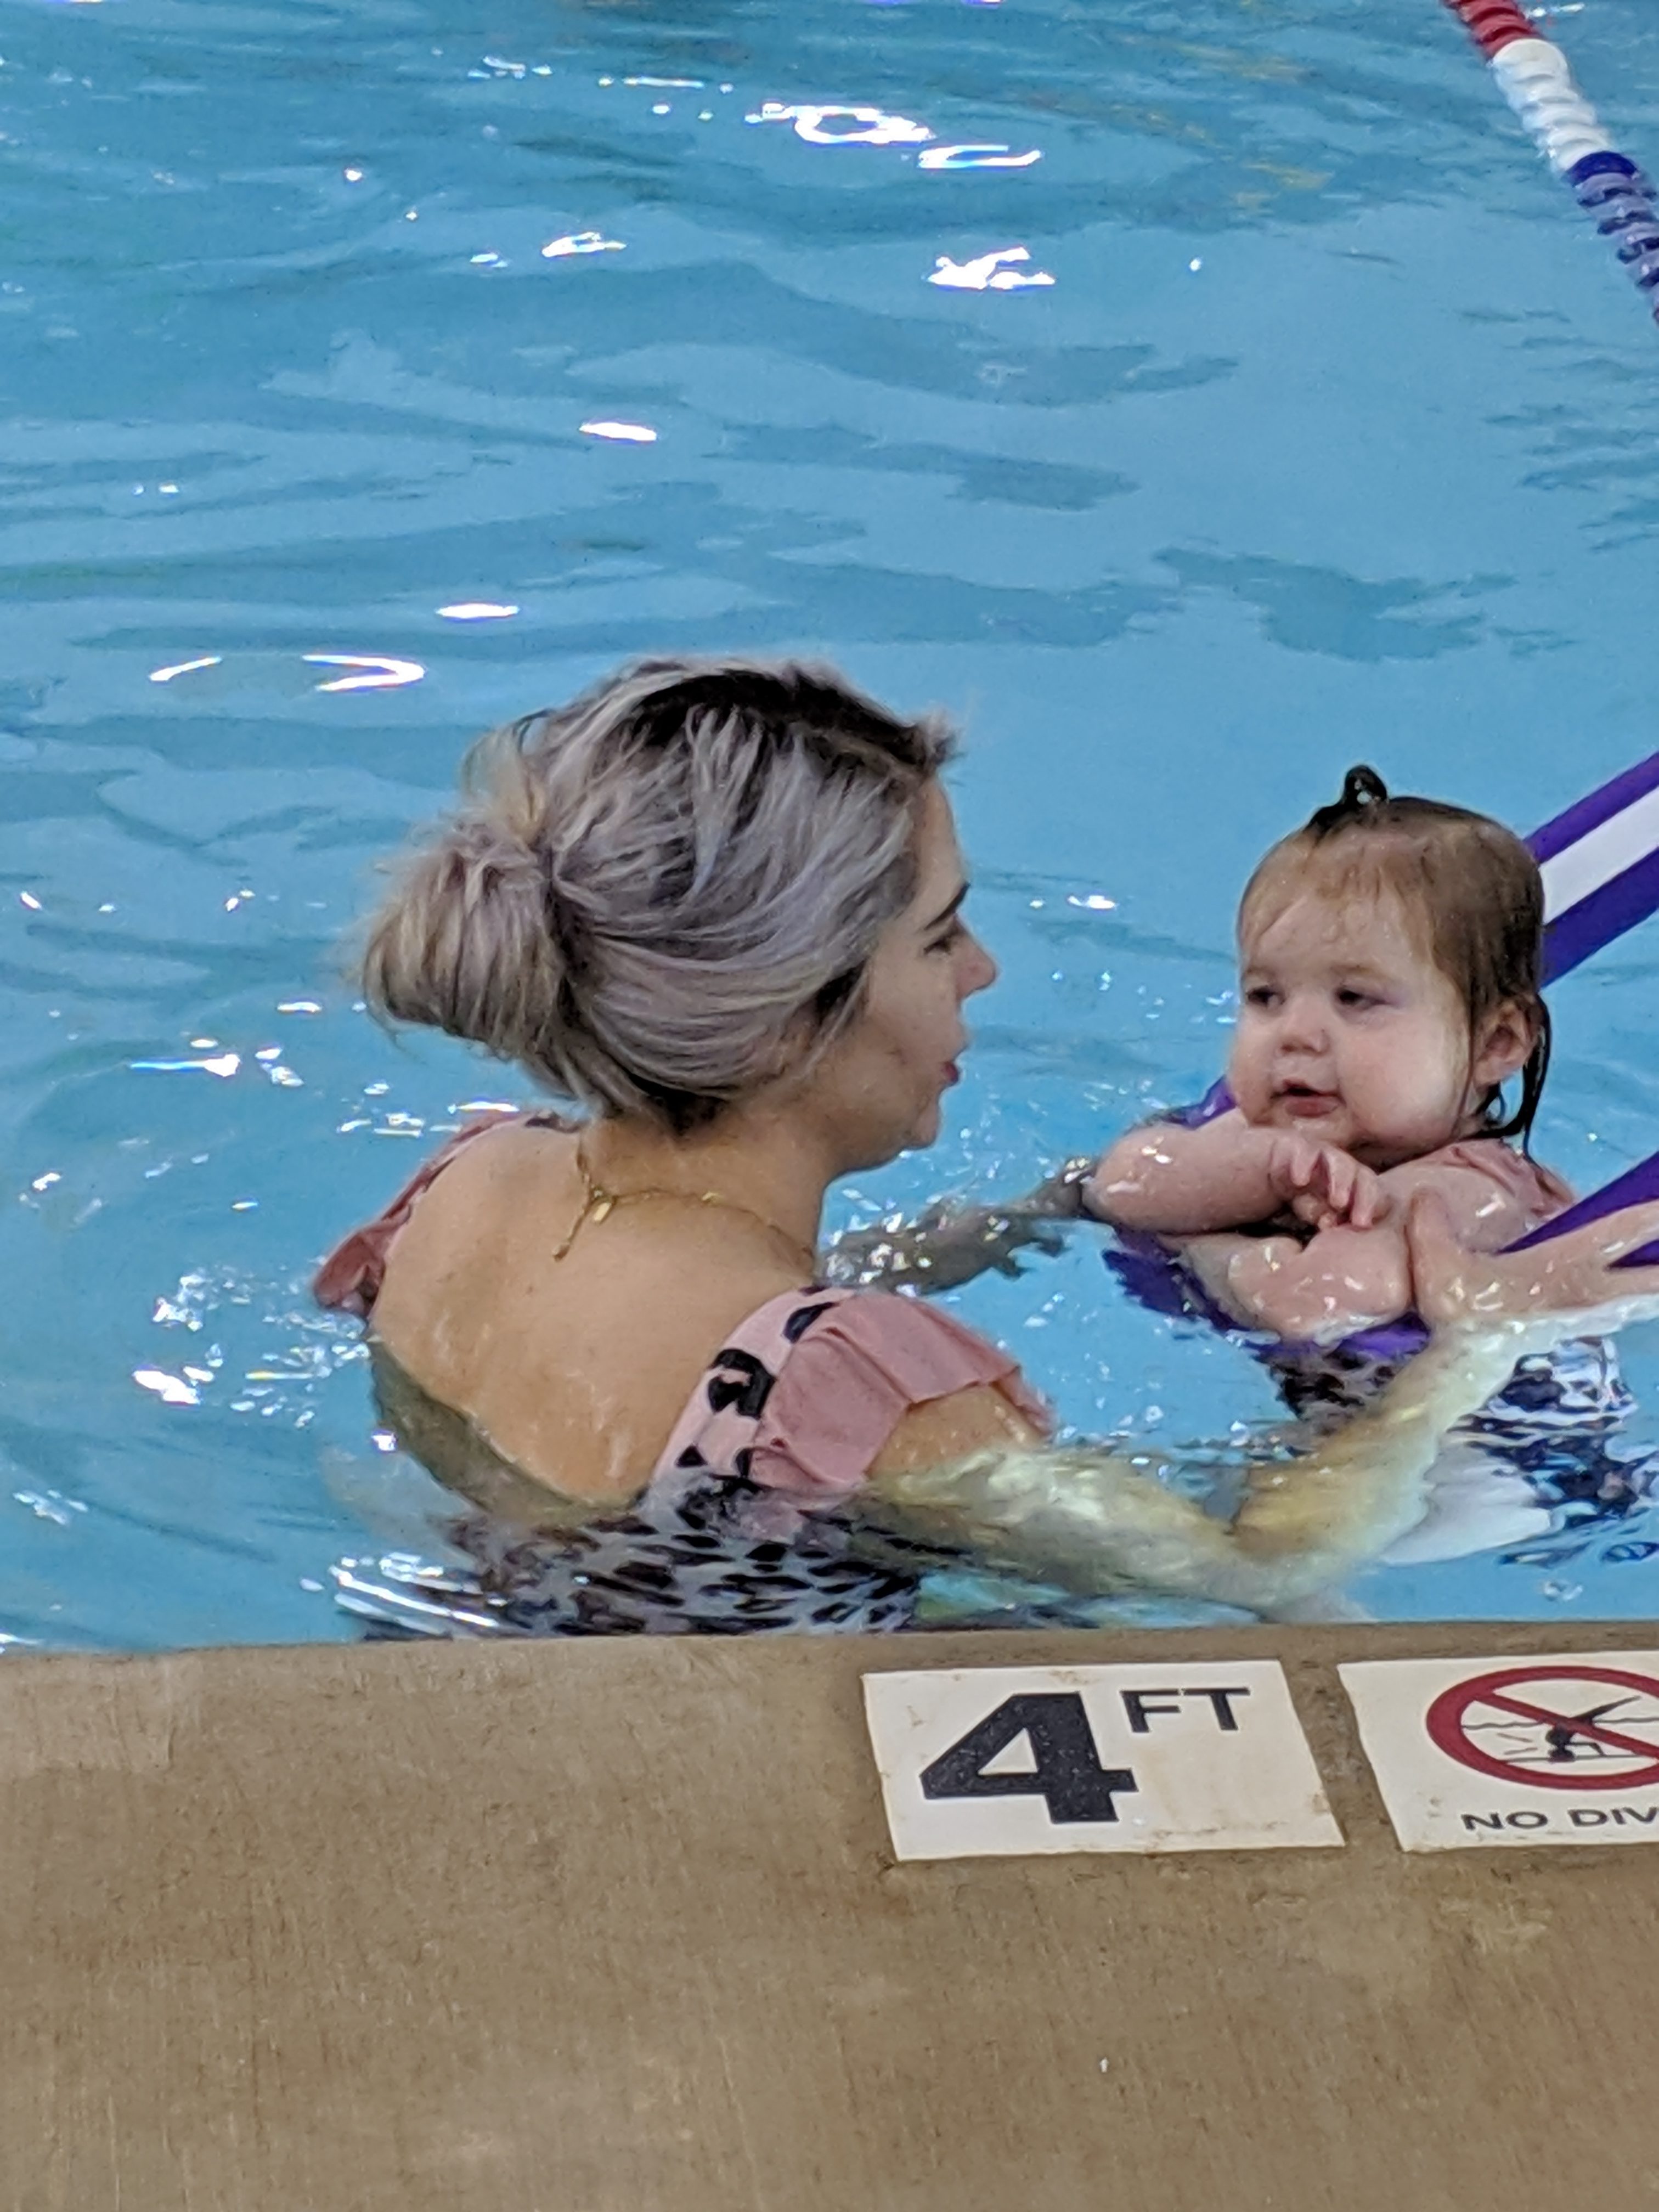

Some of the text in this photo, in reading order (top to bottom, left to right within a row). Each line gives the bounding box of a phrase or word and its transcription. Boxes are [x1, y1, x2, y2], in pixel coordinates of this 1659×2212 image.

[919, 1688, 1250, 1824] 4 FT
[1461, 1807, 1658, 1830] NO DIV
